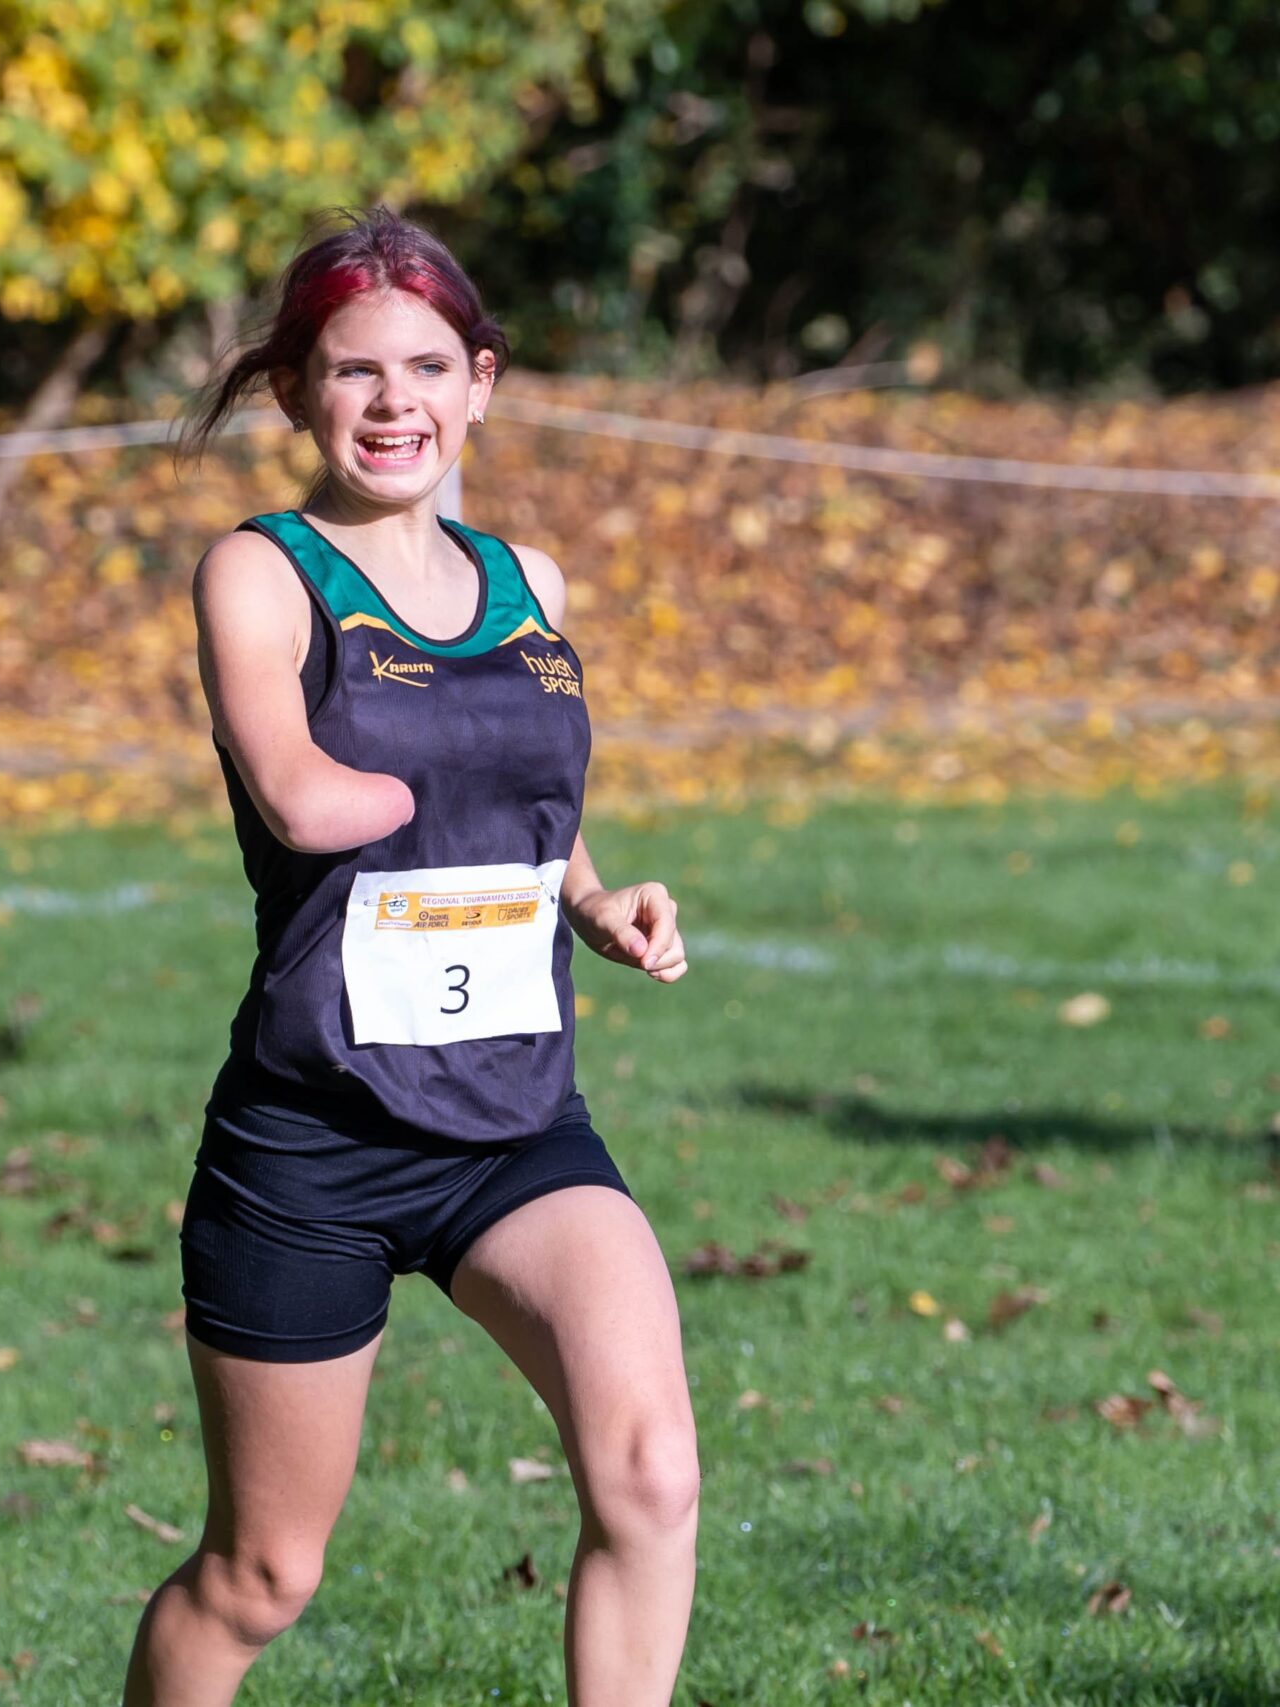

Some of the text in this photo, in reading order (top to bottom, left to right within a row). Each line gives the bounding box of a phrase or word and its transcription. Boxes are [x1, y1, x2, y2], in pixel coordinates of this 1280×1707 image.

[520, 650, 578, 680] huish
[540, 676, 582, 699] SPORT
[421, 896, 460, 906] REGIONAL
[462, 893, 514, 905] TOURNAMENTS
[429, 913, 450, 922] ROYAL
[440, 964, 471, 1015] 3
